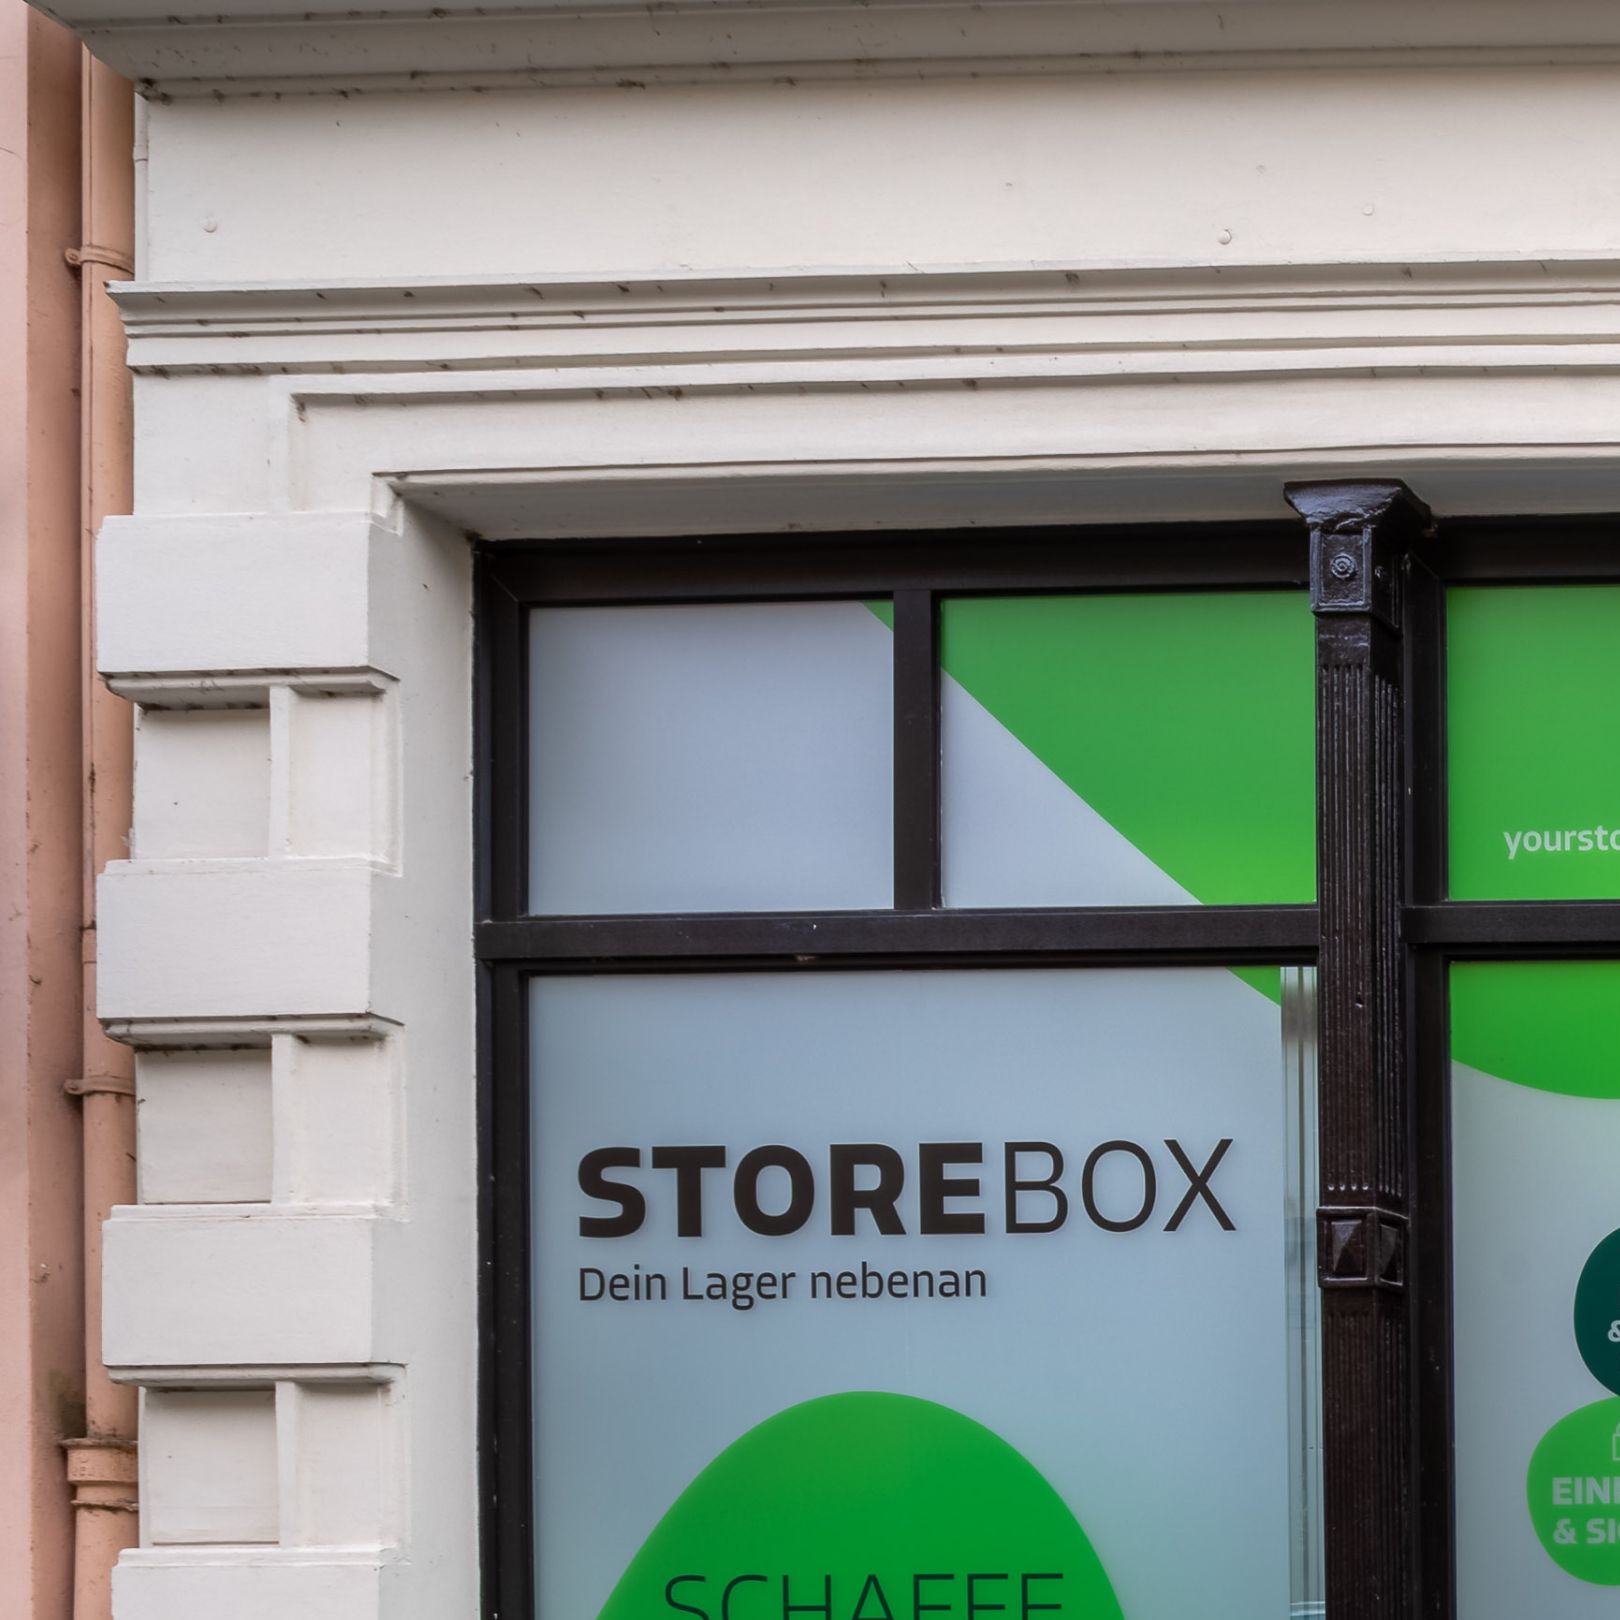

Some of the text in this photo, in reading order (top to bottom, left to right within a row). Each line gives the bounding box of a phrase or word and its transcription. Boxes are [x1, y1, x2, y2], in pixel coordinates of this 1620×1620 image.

[577, 1138, 1236, 1238] STOREBOX
[579, 1262, 987, 1311] Dein Lager nebenan
[1553, 1517, 1577, 1545] &
